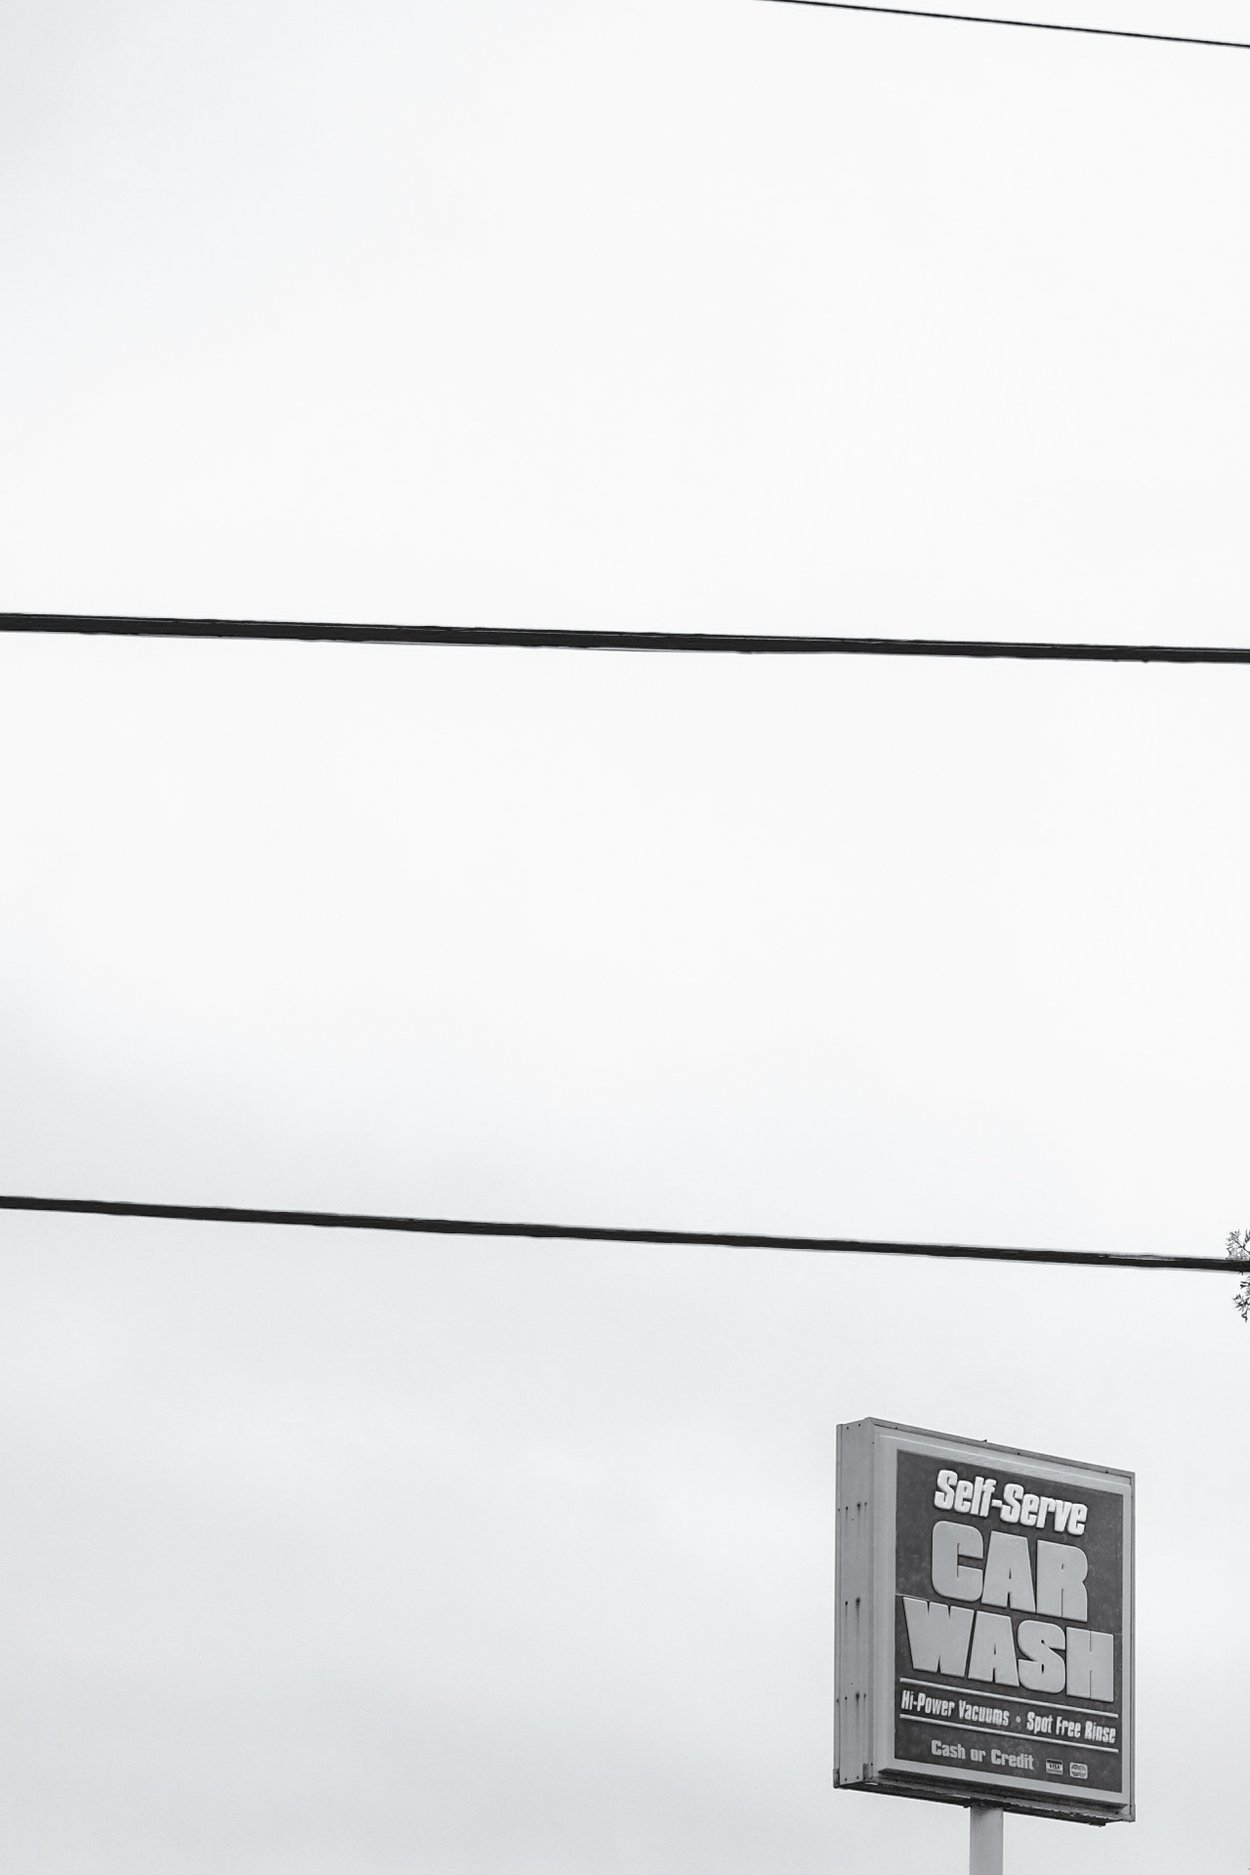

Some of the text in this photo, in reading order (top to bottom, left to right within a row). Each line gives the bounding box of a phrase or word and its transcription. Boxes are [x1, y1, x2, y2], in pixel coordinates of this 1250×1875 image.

[933, 1469, 1088, 1536] Self-Serve
[932, 1520, 1088, 1622] CAR
[903, 1596, 1114, 1703] WASH
[901, 1690, 1116, 1744] Hi-Power Vacuums Spot Free Rinse
[931, 1740, 966, 1760] Cash
[970, 1749, 987, 1763] or
[991, 1749, 1035, 1770] Credit
